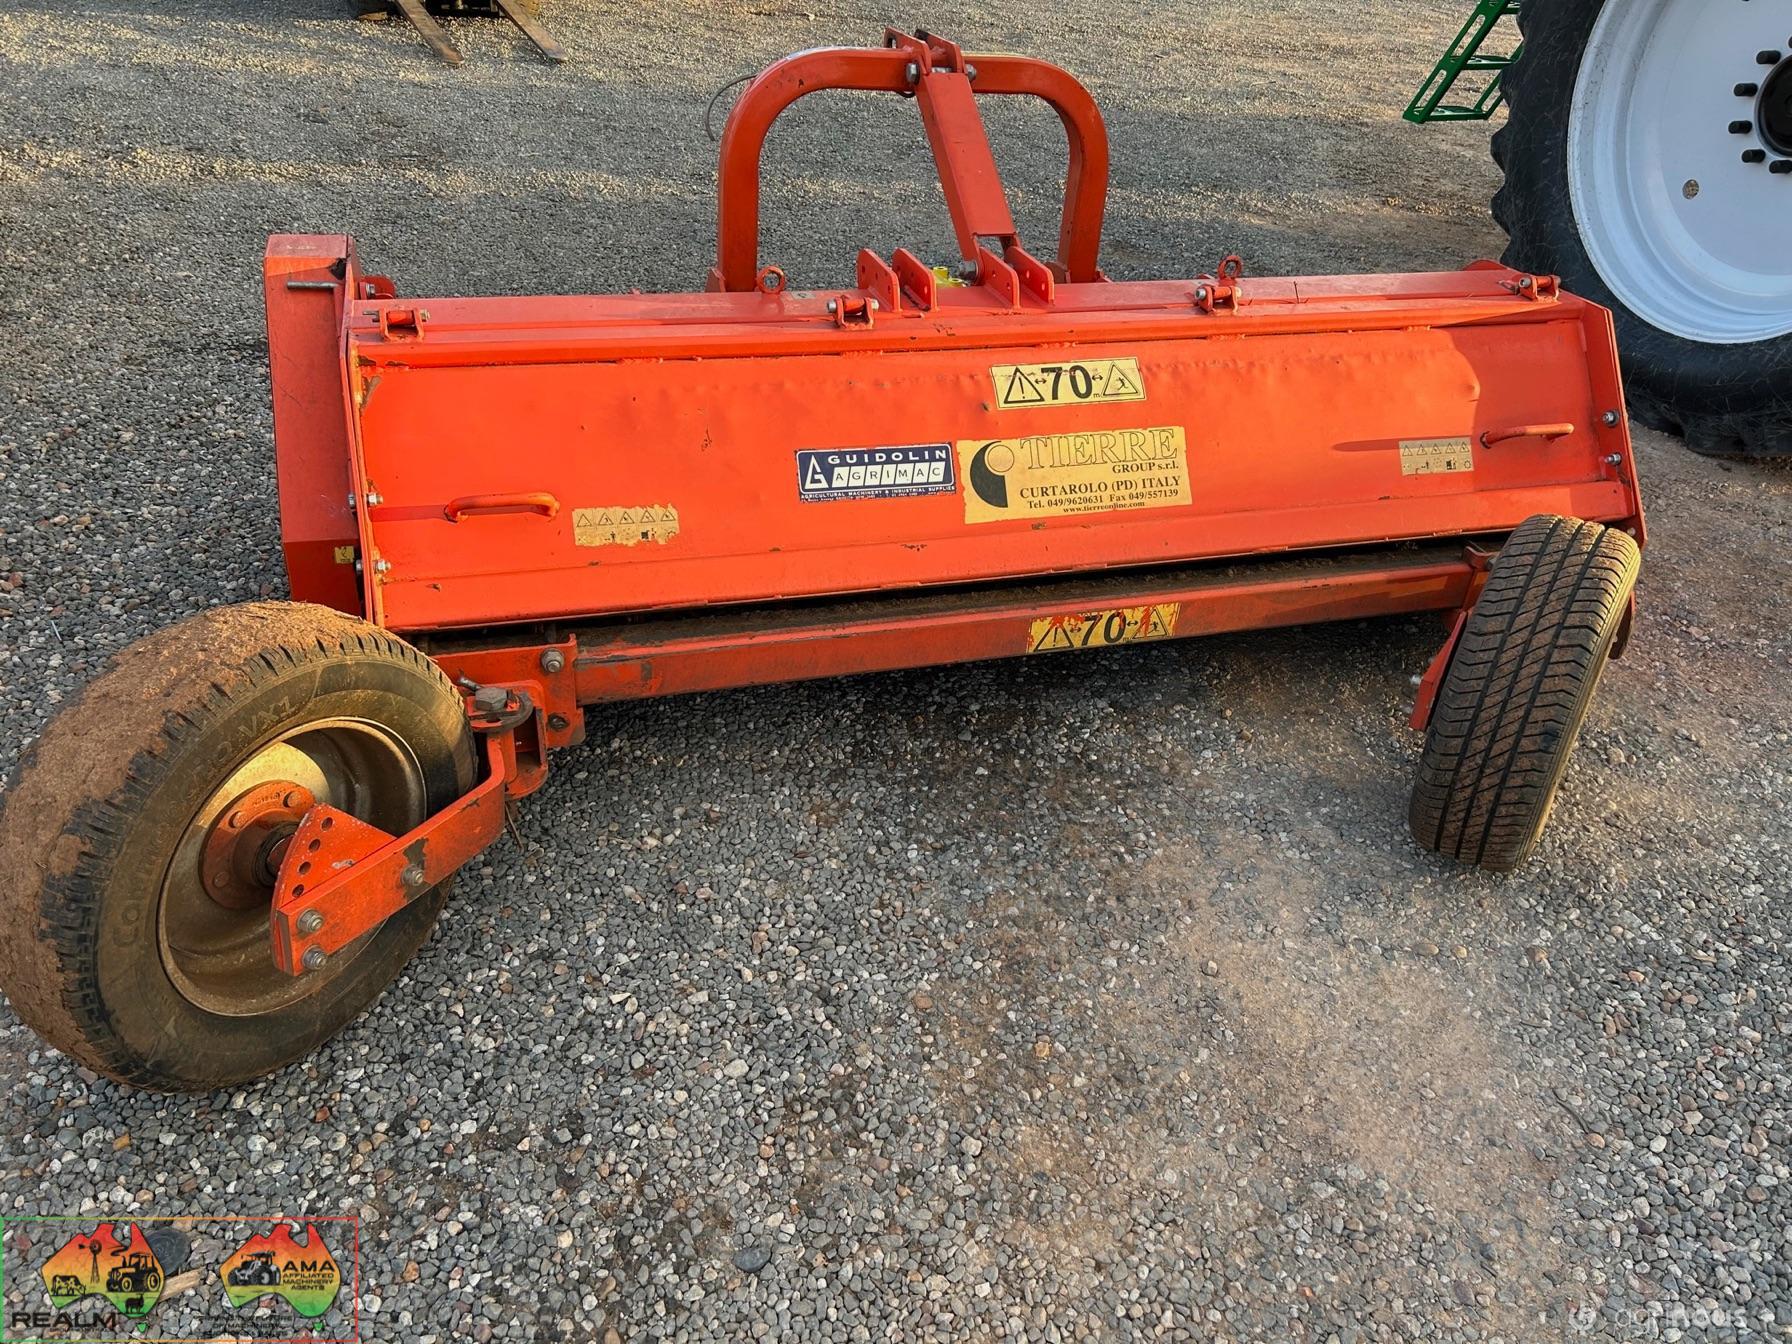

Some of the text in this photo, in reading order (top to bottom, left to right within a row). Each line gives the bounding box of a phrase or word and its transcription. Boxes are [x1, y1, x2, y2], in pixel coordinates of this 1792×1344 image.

[1041, 365, 1092, 400] 70
[828, 450, 946, 464] GUIDOLIN
[1020, 428, 1177, 470] TIERRE
[835, 467, 941, 481] AGRIMAC
[1112, 460, 1179, 473] GROUP s.r.l.
[1020, 476, 1180, 499] CURTAROLO (PD) ITALY
[1028, 489, 1179, 509] Tel. 049/9620631 Fax 049/557139
[1063, 501, 1145, 513] www.tierreonline.com
[1081, 611, 1127, 646] 70
